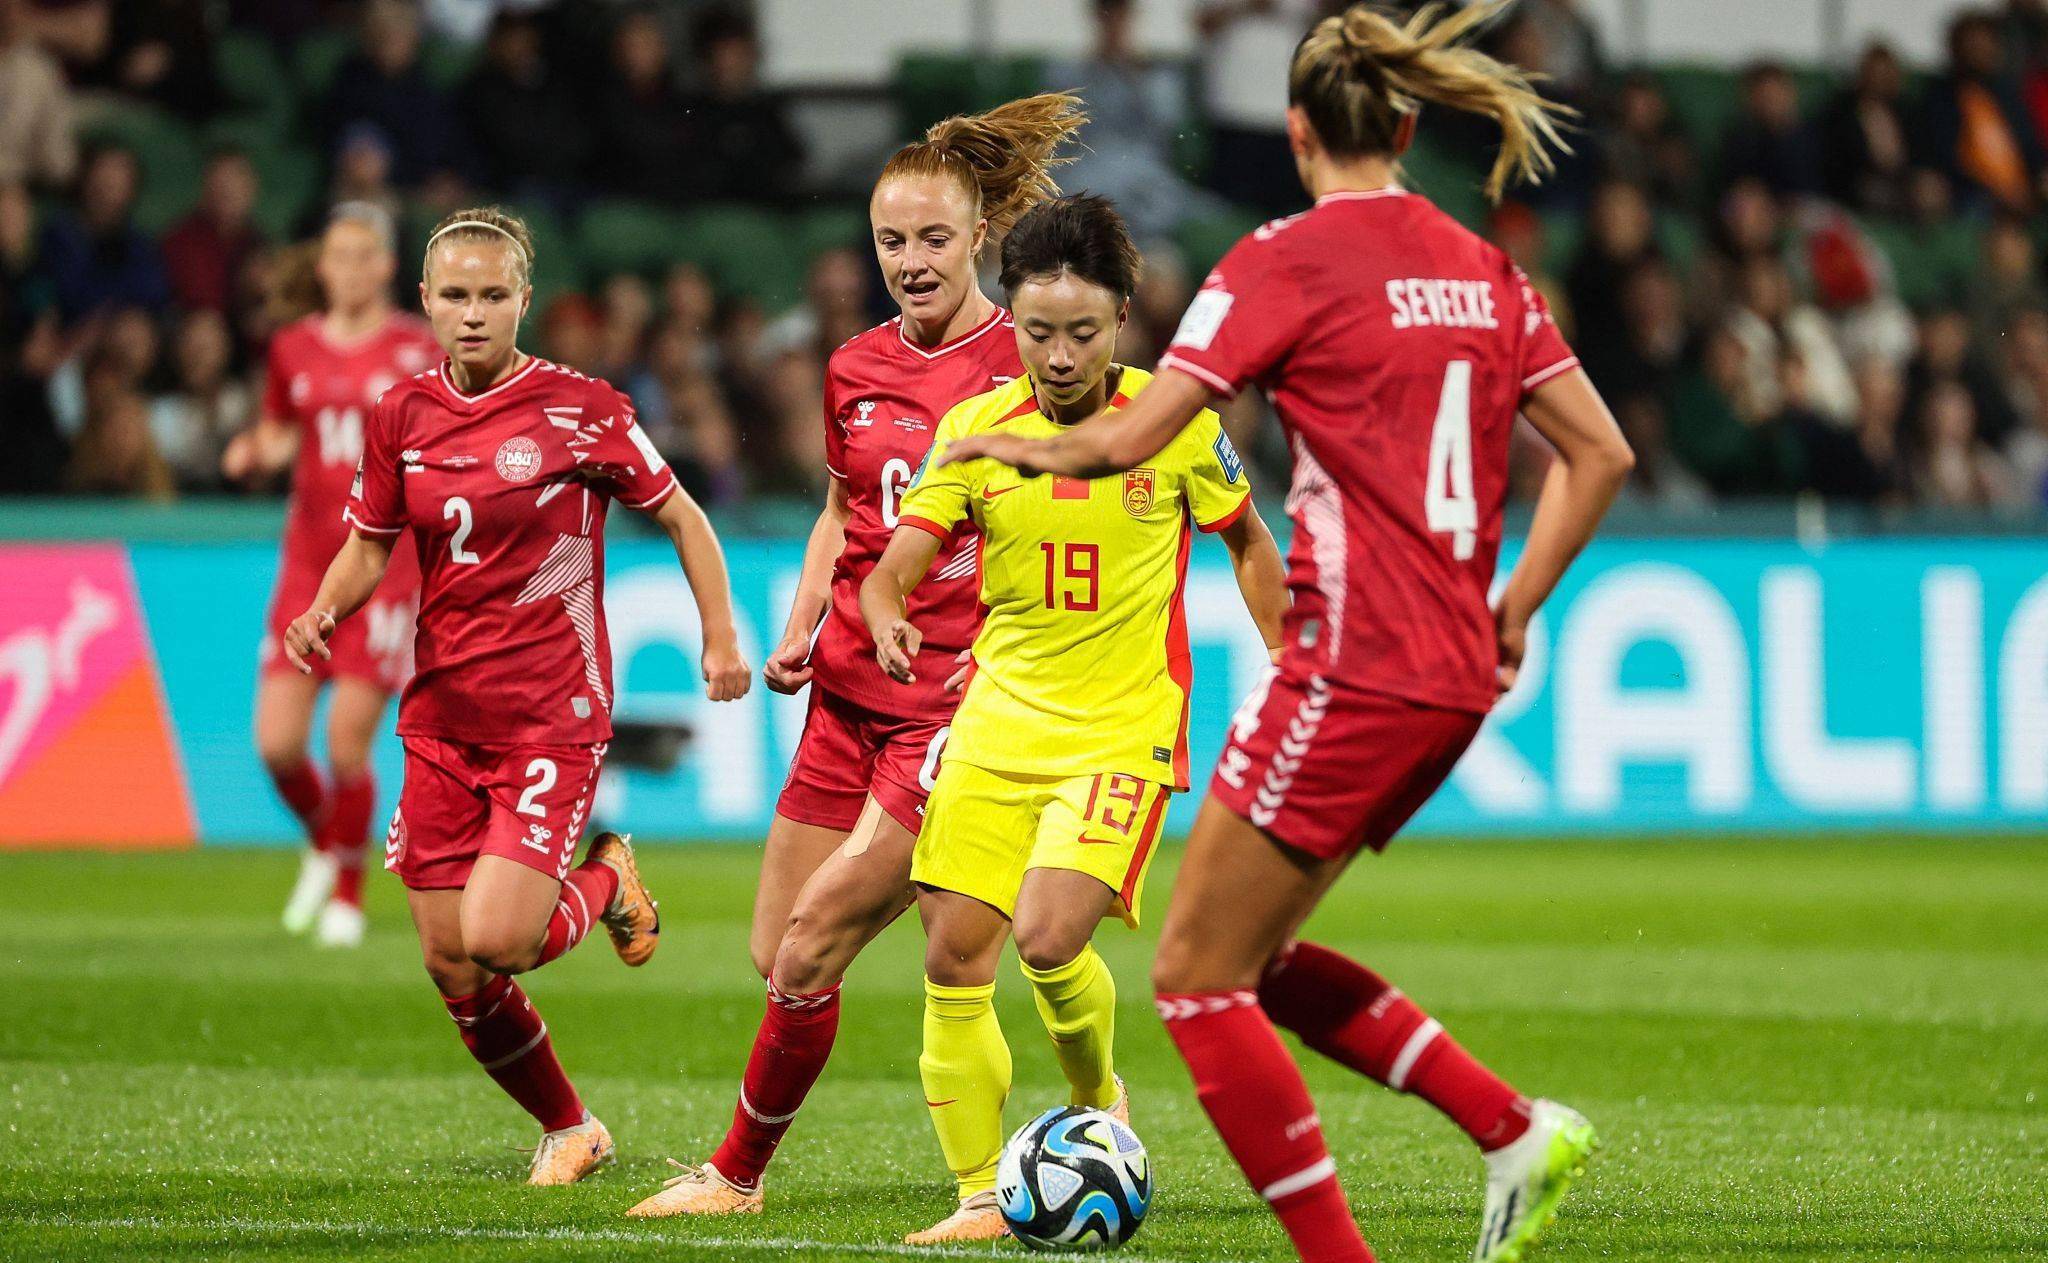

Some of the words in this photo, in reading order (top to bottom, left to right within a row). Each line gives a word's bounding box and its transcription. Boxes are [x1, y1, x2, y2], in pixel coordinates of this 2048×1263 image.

[1385, 278, 1499, 329] SEVECKE
[1126, 471, 1152, 482] CFA
[1424, 359, 1478, 562] 4
[443, 496, 480, 565] 2
[1040, 542, 1100, 612] 19
[516, 758, 557, 818] 2
[1082, 773, 1145, 836] 19
